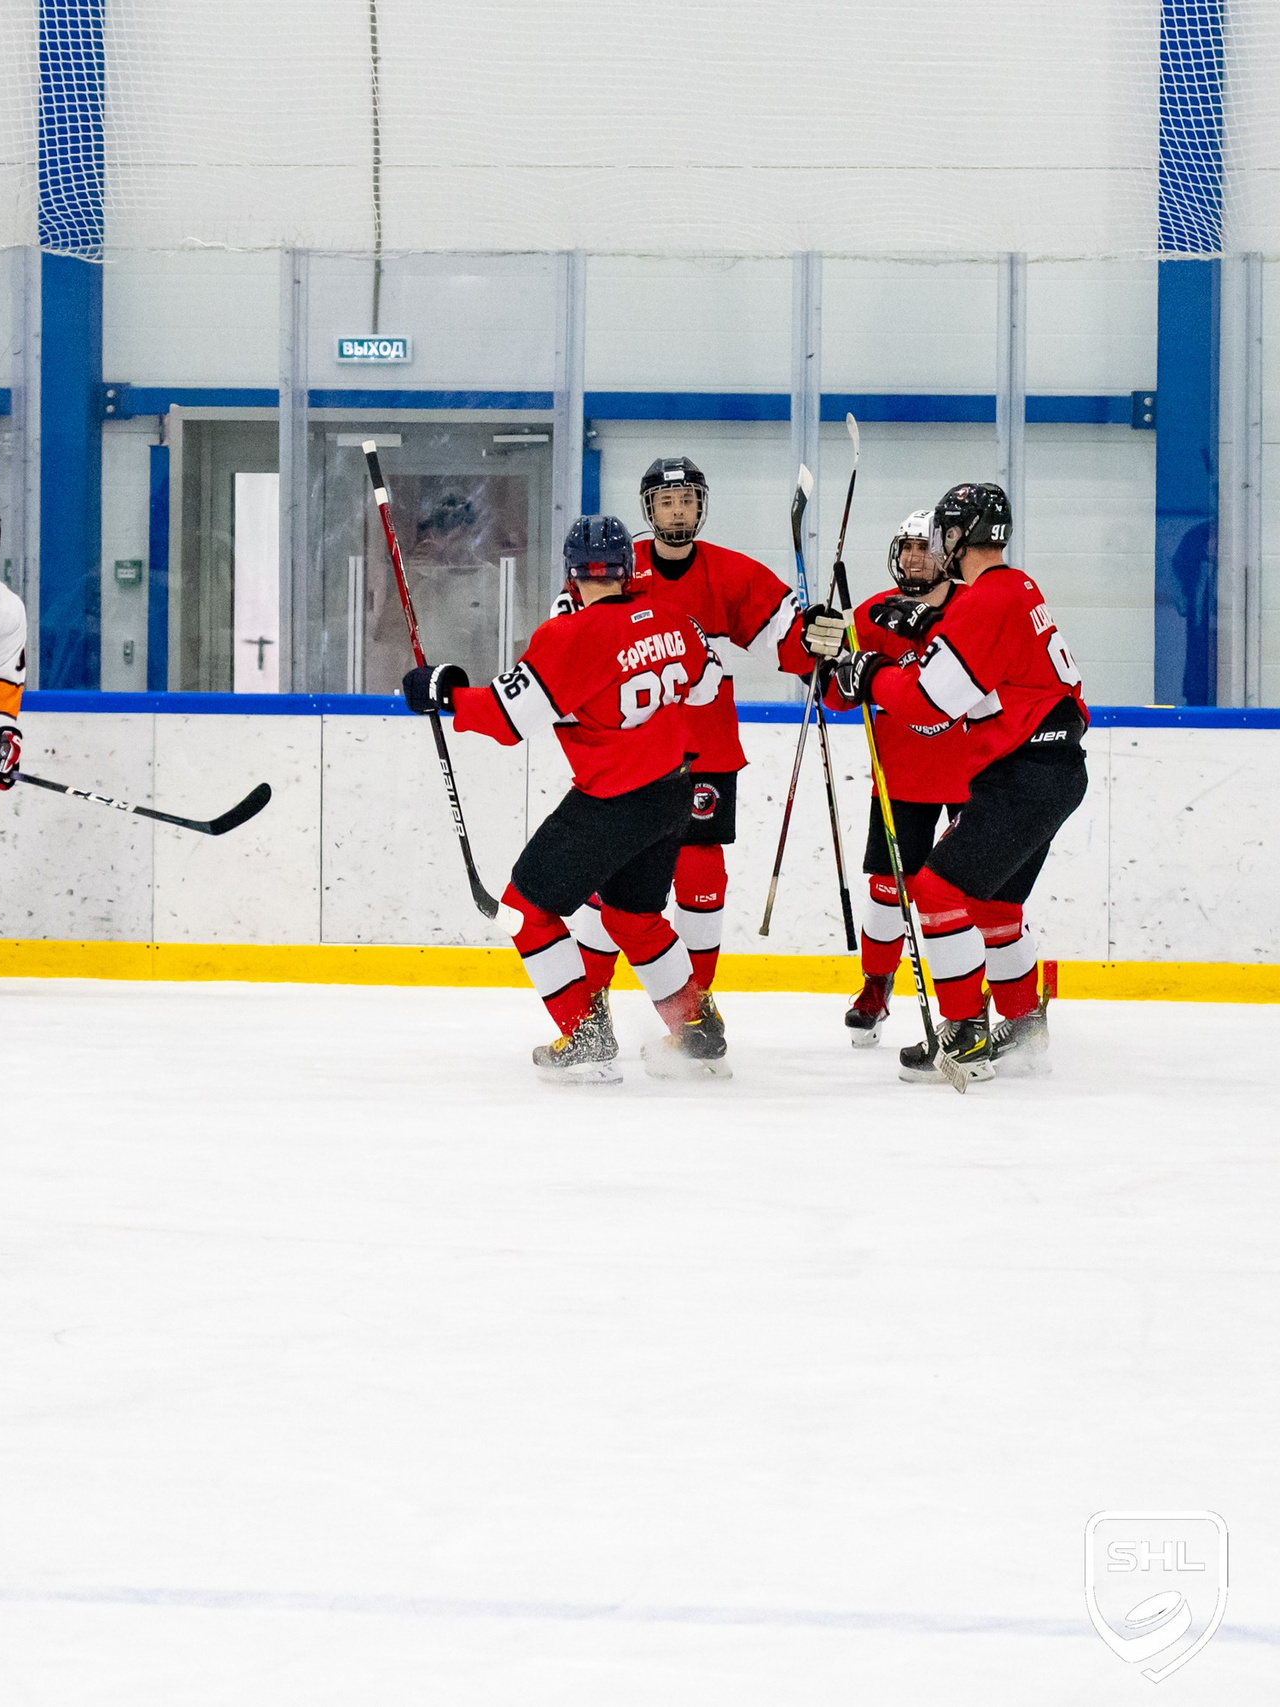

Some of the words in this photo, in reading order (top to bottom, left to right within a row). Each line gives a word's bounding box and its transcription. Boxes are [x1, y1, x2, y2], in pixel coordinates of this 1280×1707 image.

[342, 341, 404, 358] ВЫХОД
[990, 524, 1006, 541] 91
[1030, 730, 1068, 743] UER
